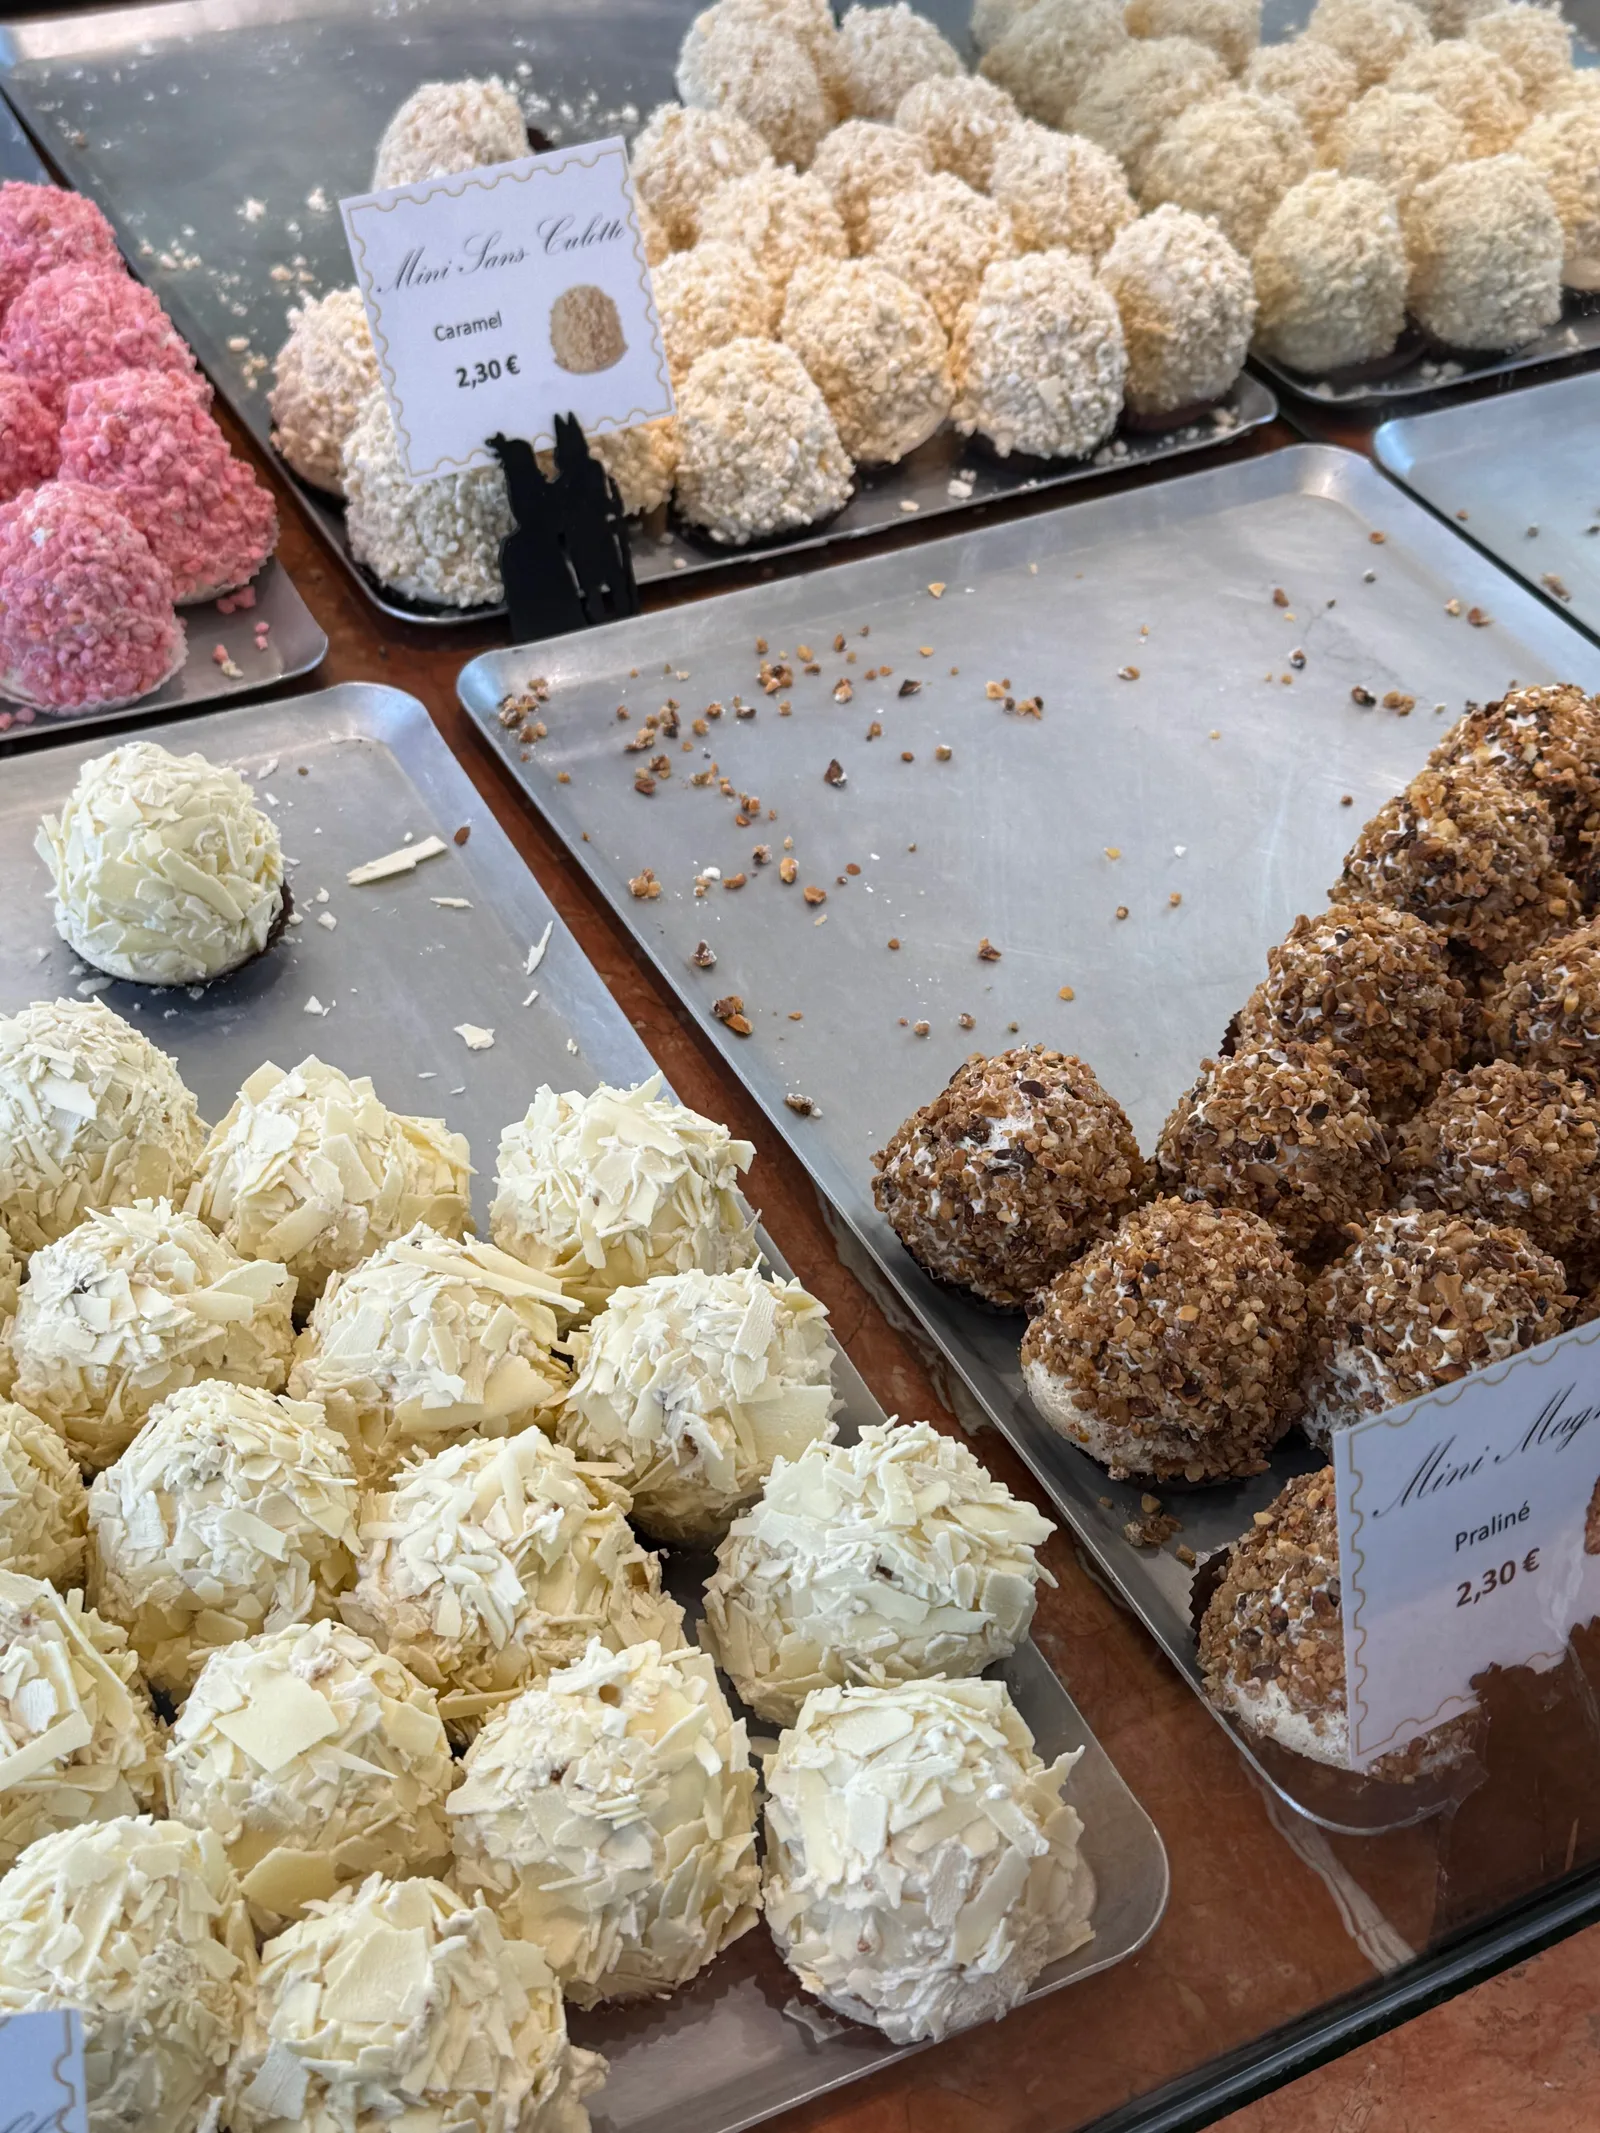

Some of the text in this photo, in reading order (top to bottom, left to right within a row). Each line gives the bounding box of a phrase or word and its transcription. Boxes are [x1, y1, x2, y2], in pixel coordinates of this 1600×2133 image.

[376, 212, 626, 295] Mini Sans Culotte
[433, 311, 503, 343] Caramel
[1372, 1434, 1489, 1518] Mini
[1455, 1500, 1531, 1552] Praliné
